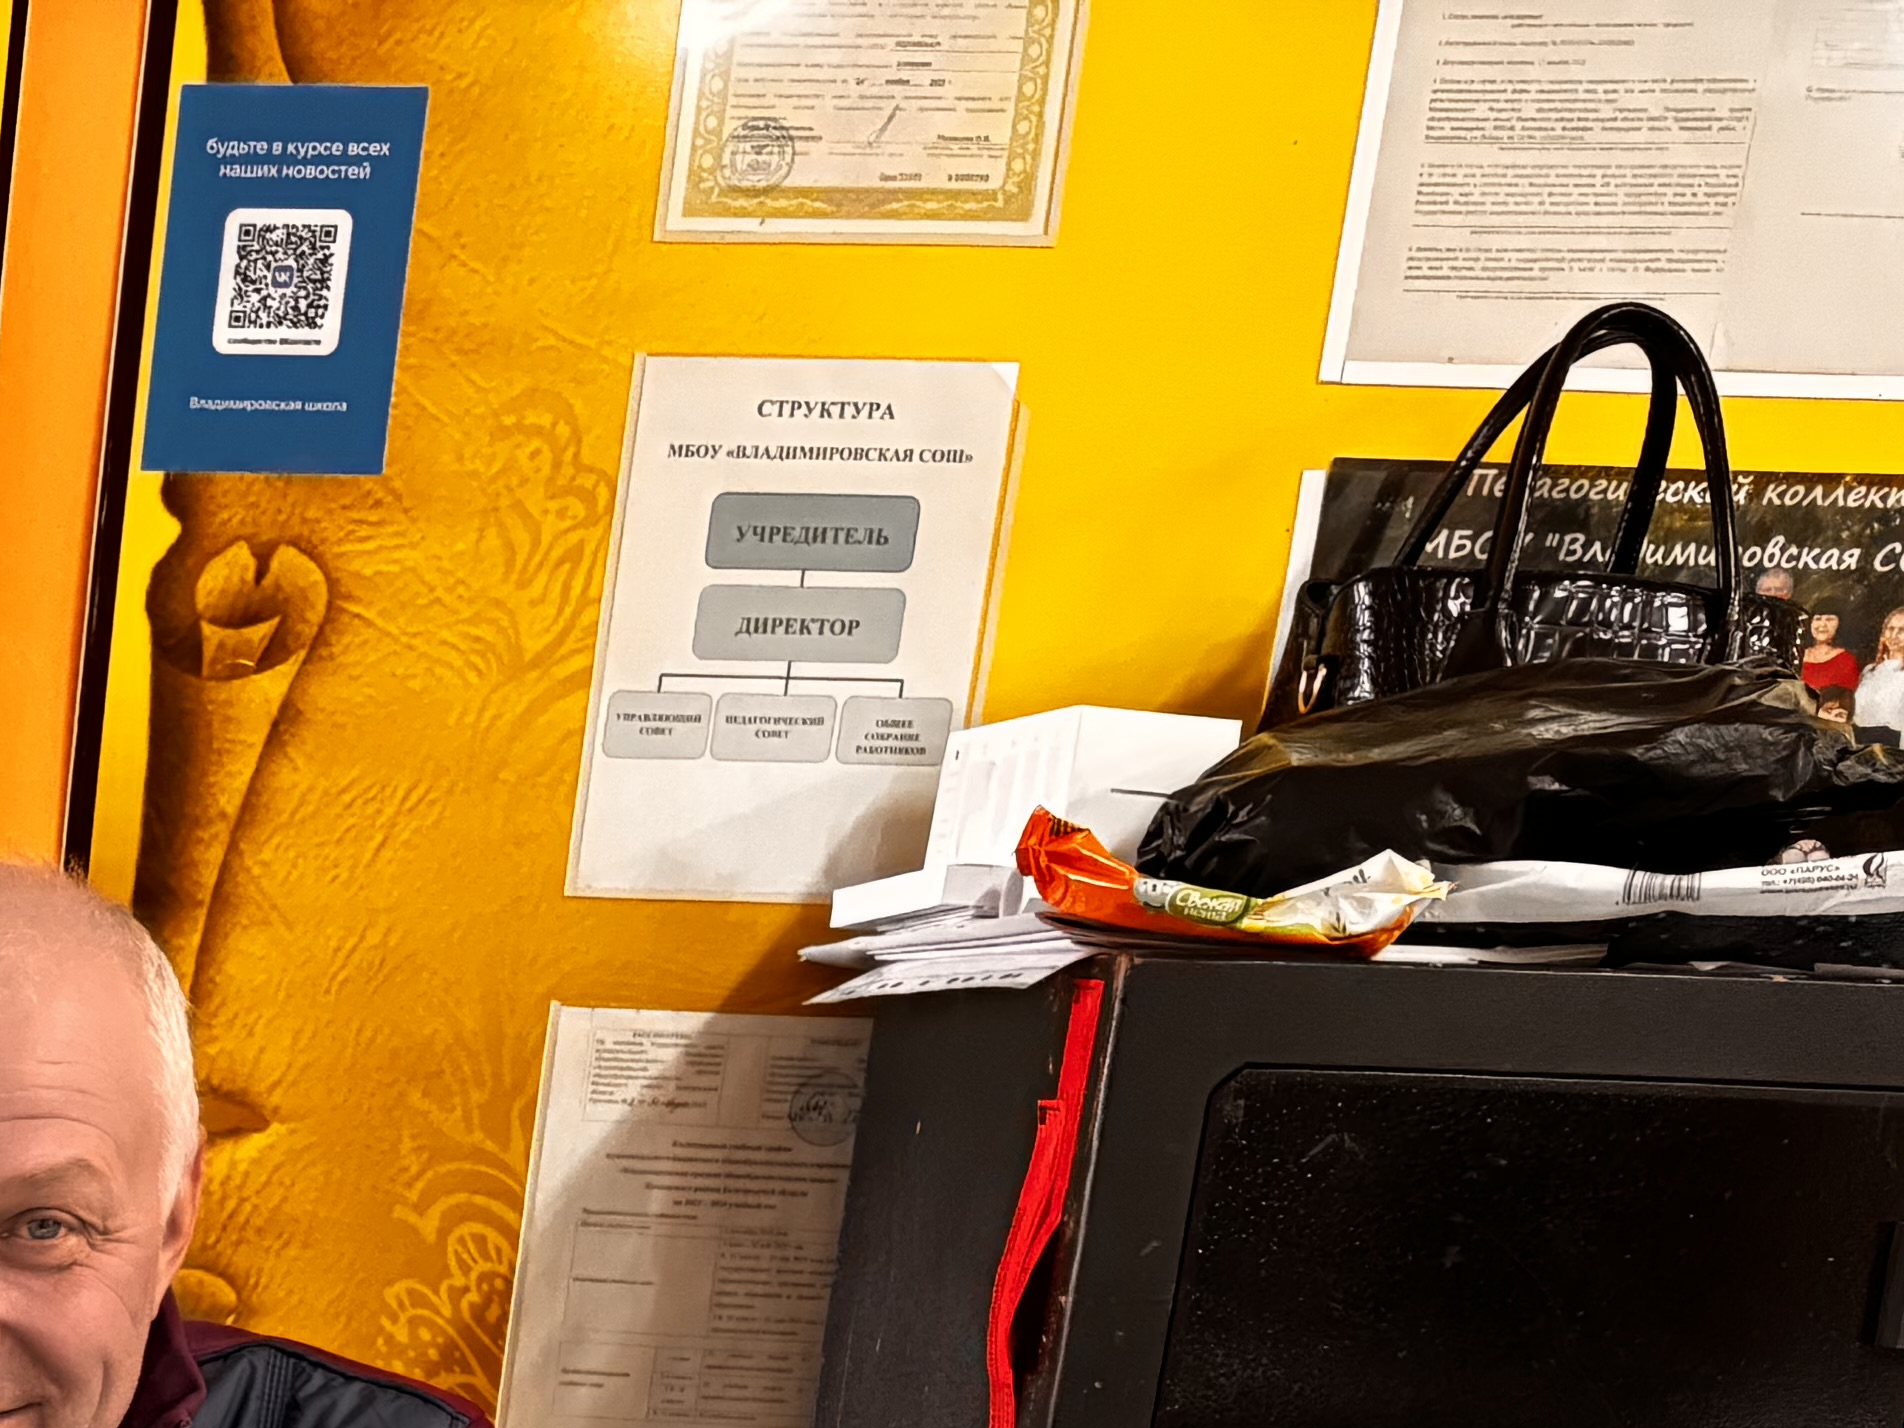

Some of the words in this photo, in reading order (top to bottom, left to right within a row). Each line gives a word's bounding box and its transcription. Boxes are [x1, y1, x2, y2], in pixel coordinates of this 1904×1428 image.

[206, 137, 268, 158] будьте
[272, 141, 283, 155] в
[287, 141, 343, 159] курсе
[347, 141, 390, 156] всех
[218, 163, 278, 178] наших
[282, 161, 372, 179] новостей
[756, 398, 896, 421] СТРУКТУРА
[667, 443, 723, 459] МБОУ
[726, 444, 914, 463] «ВЛАДИМИРОВСКАЯ
[918, 447, 974, 464] СОШ»
[733, 522, 890, 548] УЧРЕДИТЕЛЬ
[733, 614, 861, 639] ДИРЕКТОР
